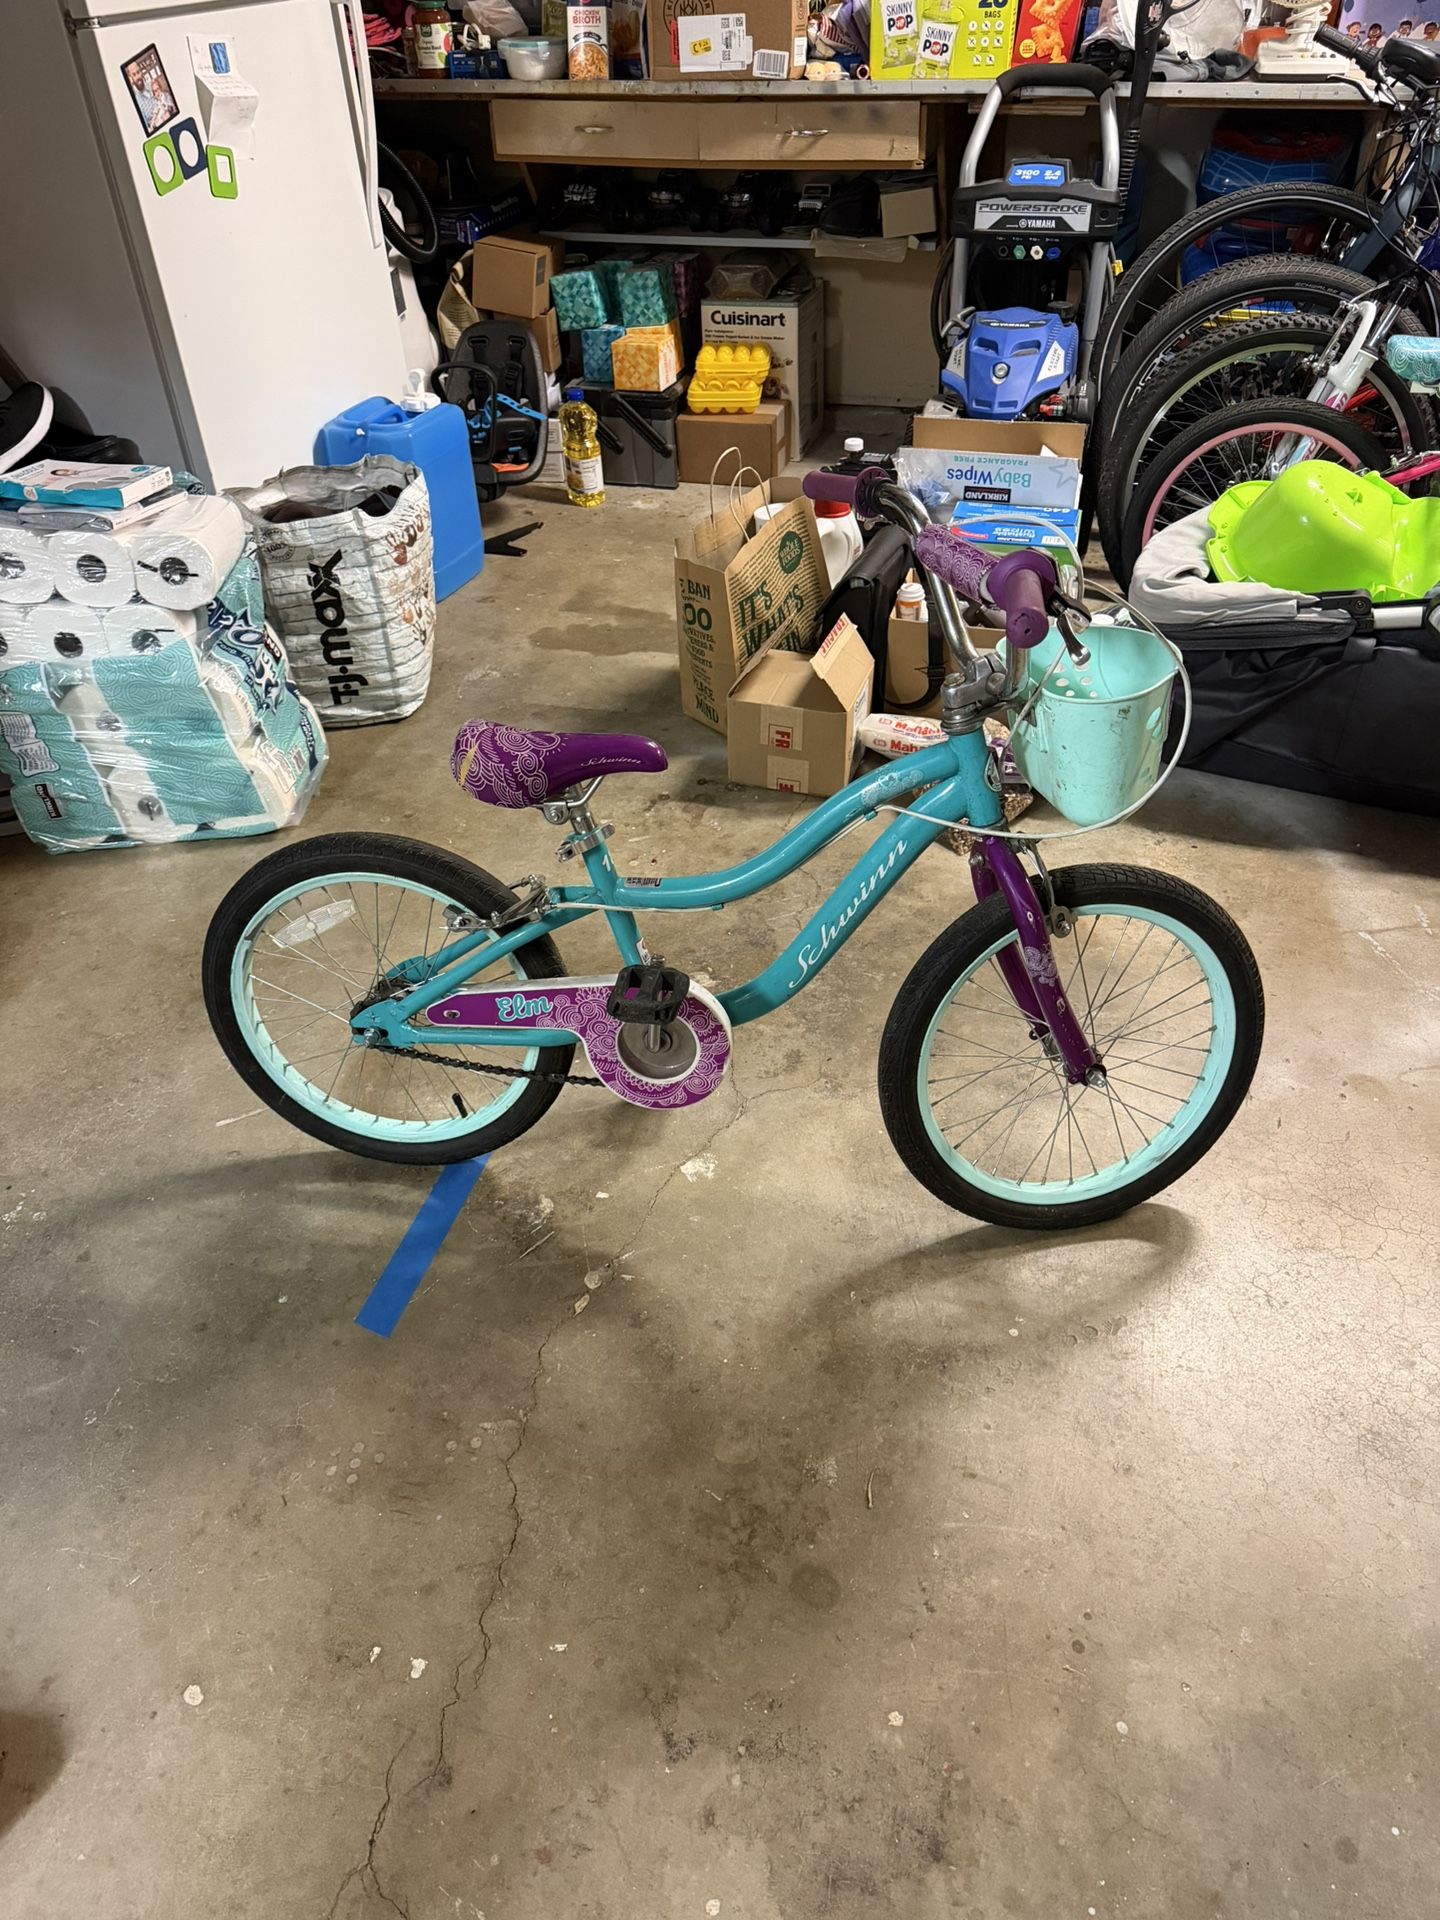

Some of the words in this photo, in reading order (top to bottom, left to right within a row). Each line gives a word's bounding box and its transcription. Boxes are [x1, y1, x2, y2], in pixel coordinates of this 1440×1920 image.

[572, 16, 601, 24] BROTH
[888, 15, 914, 31] POP
[922, 39, 949, 57] POP
[979, 203, 1087, 214] POWERSTROKE
[1027, 219, 1056, 229] YAMAHA
[711, 310, 786, 327] Cuisinart
[976, 455, 1029, 466] FRAGRANCE
[947, 466, 993, 485] Wipes
[994, 468, 1032, 488] Baby
[965, 492, 1009, 501] KIRKLAND
[687, 579, 711, 601] BAN
[738, 580, 773, 630] IT'S
[695, 694, 719, 724] MIND
[580, 757, 642, 767] Schwinn
[788, 839, 908, 989] Schwinn
[495, 993, 554, 1022] Elm
